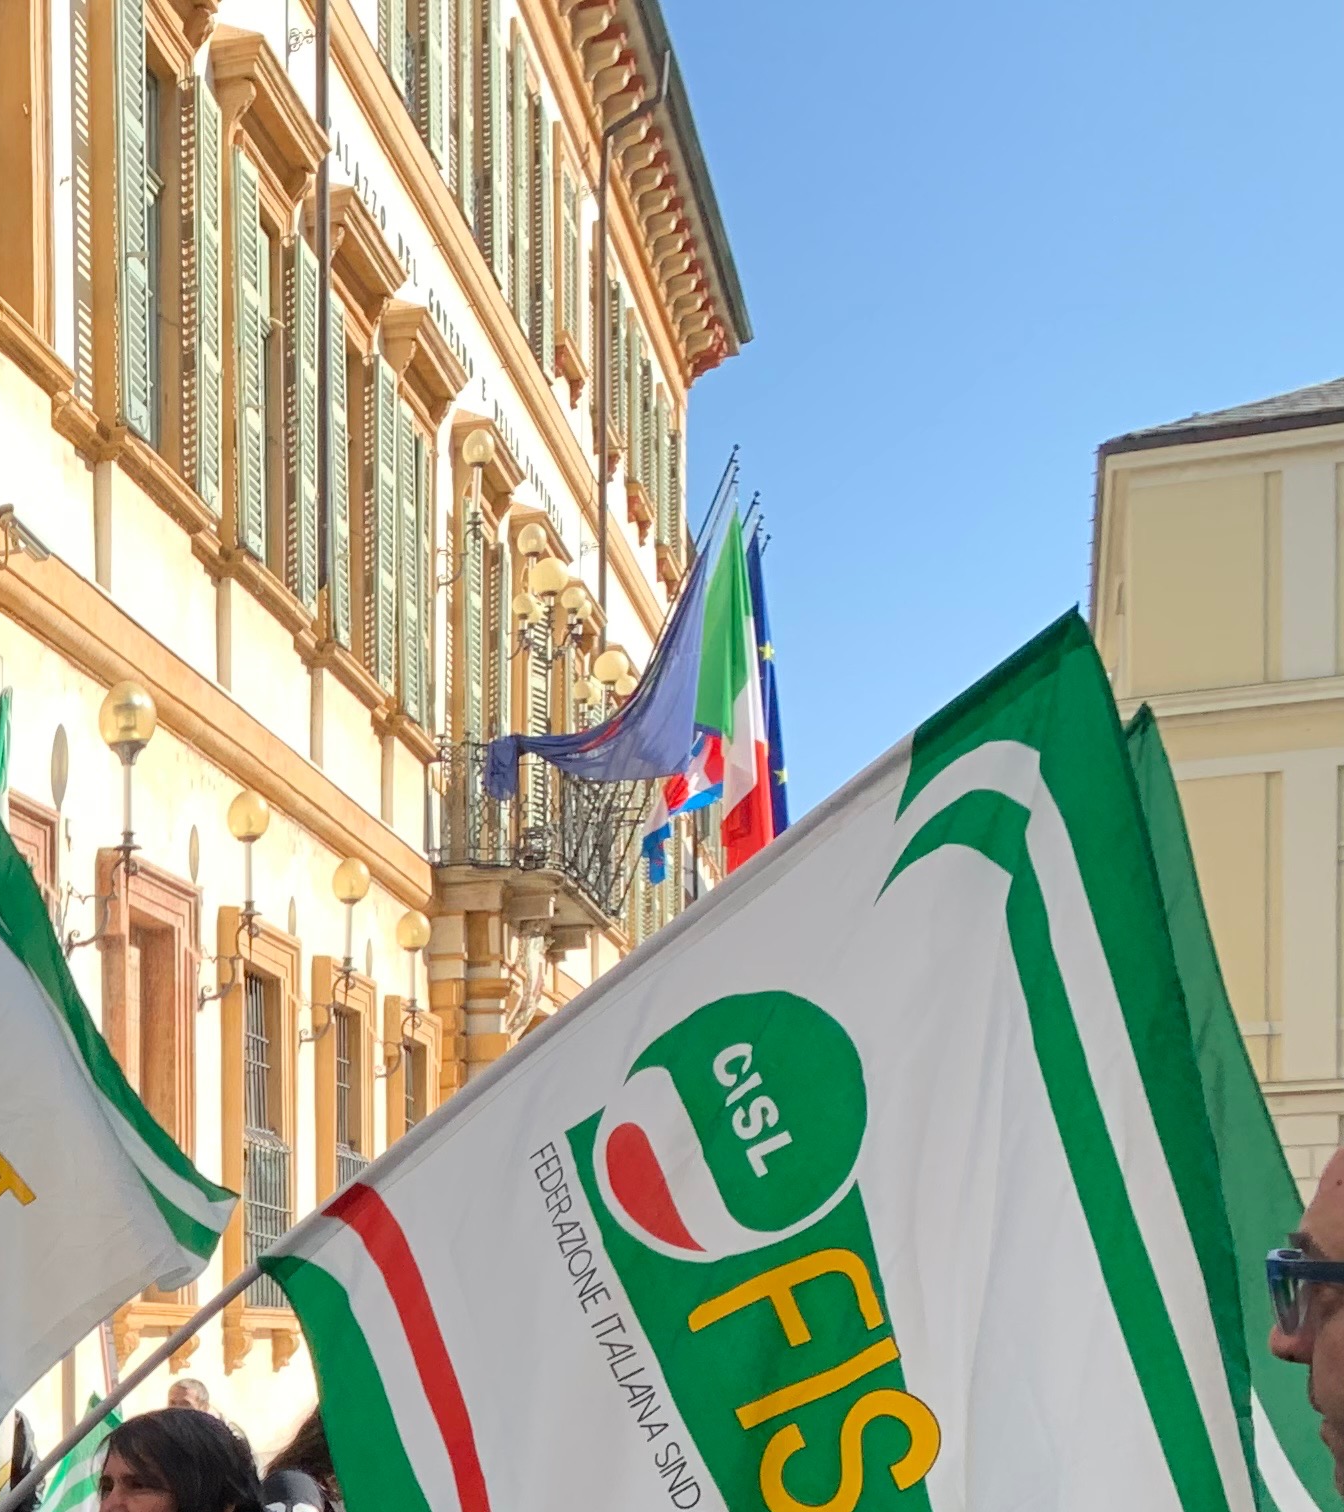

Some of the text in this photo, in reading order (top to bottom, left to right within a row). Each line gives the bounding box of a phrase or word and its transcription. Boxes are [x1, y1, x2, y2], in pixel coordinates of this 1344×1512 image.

[398, 232, 418, 288] DEL
[428, 287, 474, 379] GOVERNO
[494, 399, 520, 460] DELLA
[713, 1040, 796, 1181] CISL
[530, 1141, 612, 1315] FEDERAZIONE
[590, 1312, 666, 1443] ITALIANA
